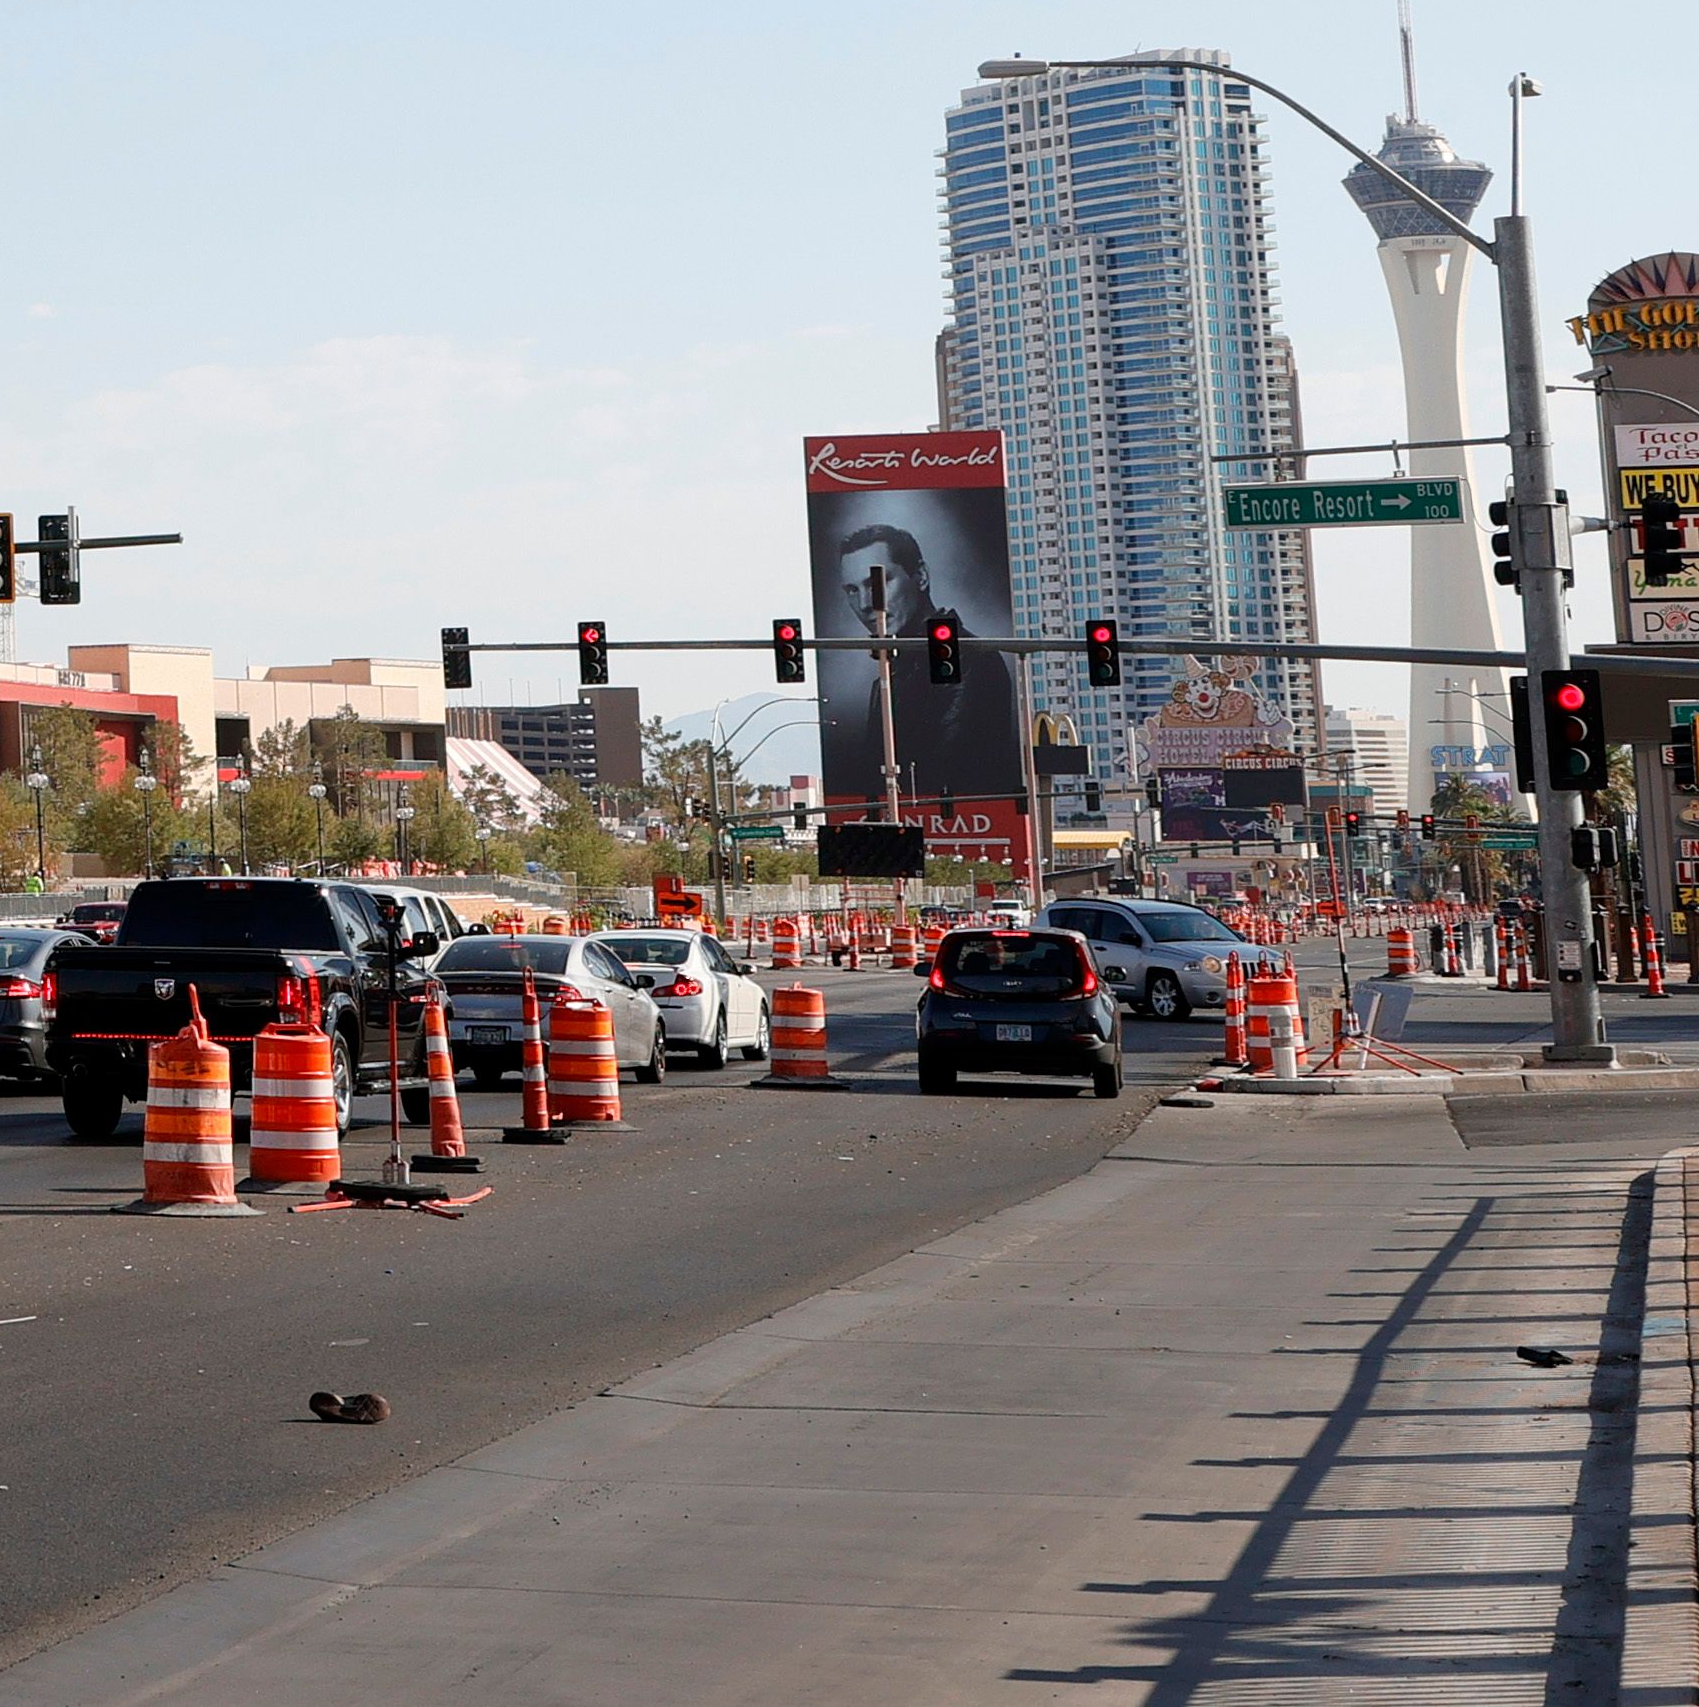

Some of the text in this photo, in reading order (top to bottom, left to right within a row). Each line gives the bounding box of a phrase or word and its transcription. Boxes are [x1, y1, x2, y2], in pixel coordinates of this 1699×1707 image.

[1565, 306, 1626, 346] THE
[1628, 330, 1699, 351] SHO
[809, 442, 998, 485] Resorts World
[1625, 473, 1699, 505] WE BUY
[1228, 483, 1453, 522] E Encore Resort BLVD
[1424, 505, 1450, 518] 100
[1157, 731, 1211, 746] CIRCUS
[1158, 748, 1210, 765] HOTEL
[1225, 757, 1303, 770] CIRCUS CIRCUS
[1431, 745, 1511, 767] STRAT
